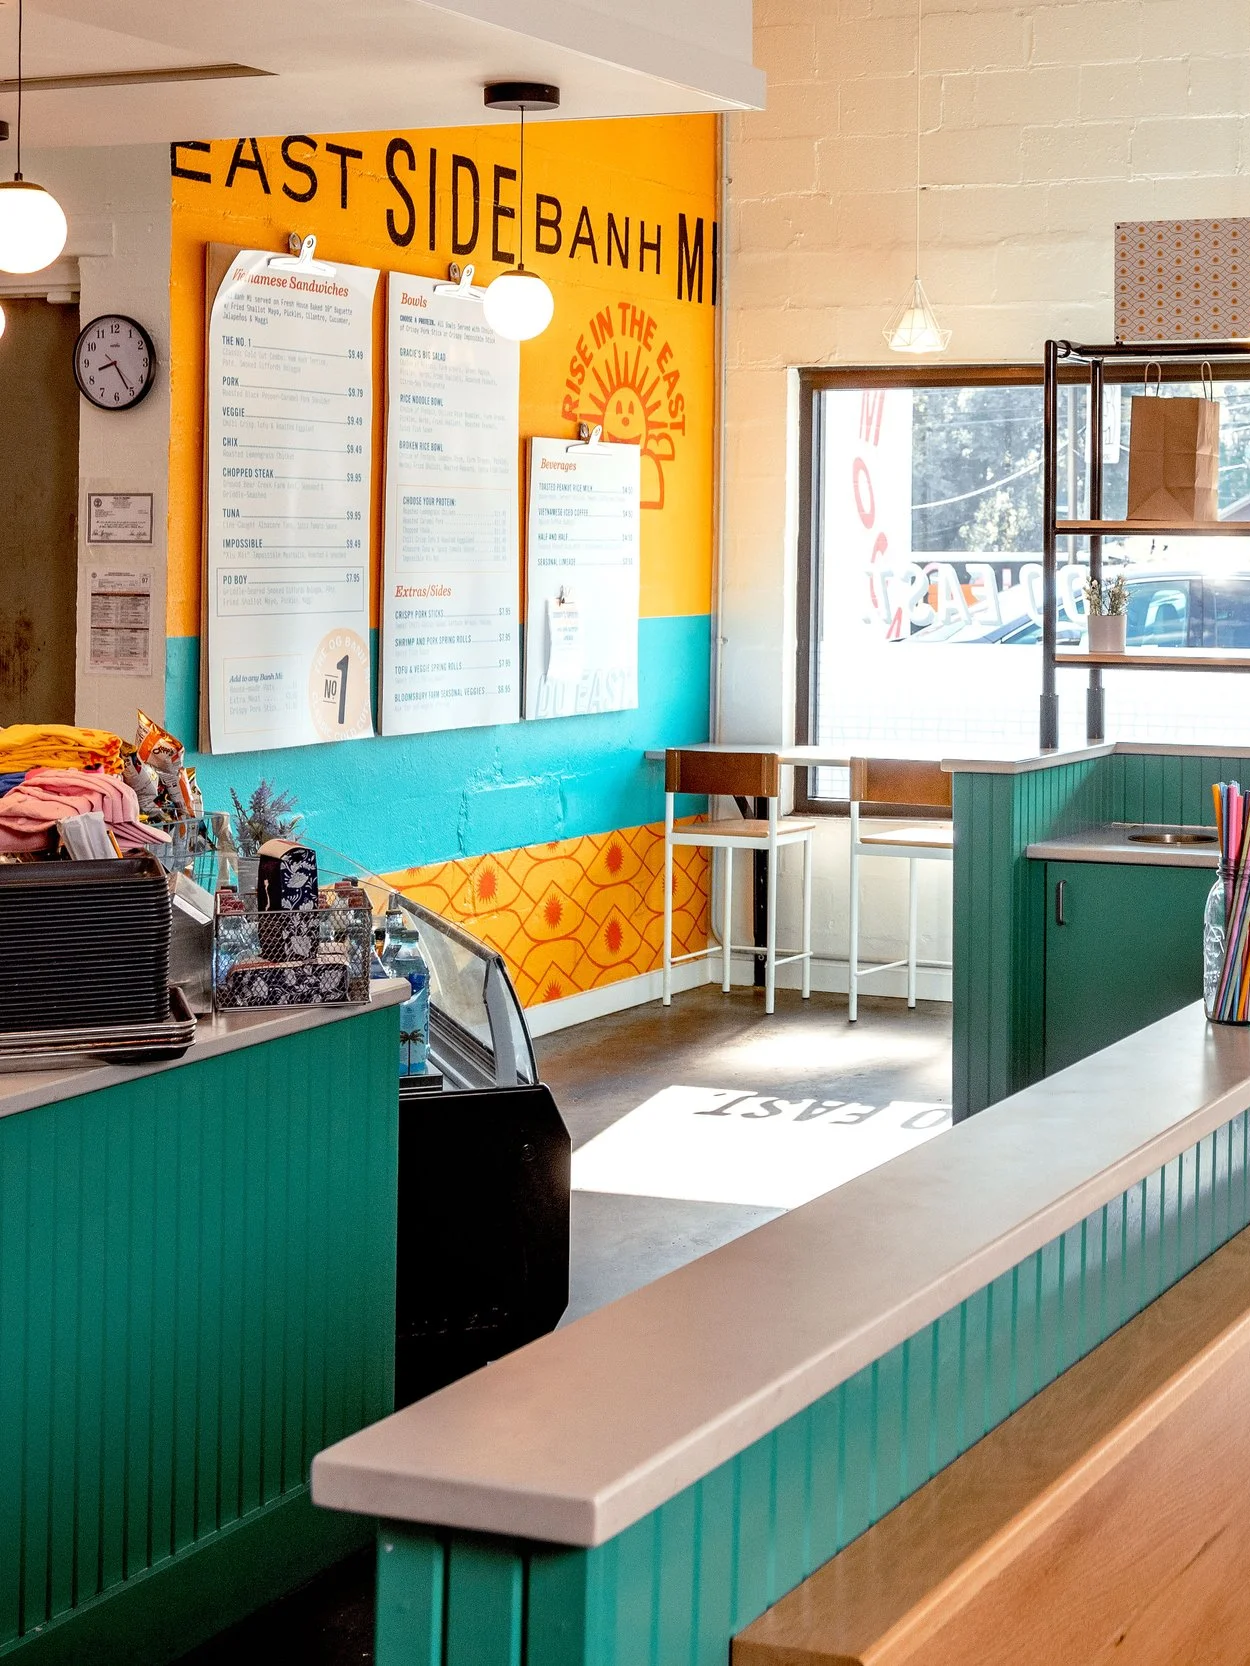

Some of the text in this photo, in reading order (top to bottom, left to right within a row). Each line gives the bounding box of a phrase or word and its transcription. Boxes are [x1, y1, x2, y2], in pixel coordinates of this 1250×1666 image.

[170, 135, 363, 209] EAST
[385, 137, 517, 265] SIDE
[535, 193, 661, 275] BANH
[232, 268, 349, 297] Vienamese Sandwiches
[401, 293, 427, 308] Bowls
[97, 329, 105, 338] 11
[110, 324, 120, 334] 12
[128, 329, 132, 338] 1
[87, 342, 96, 352] 10
[137, 340, 143, 350] 2
[222, 335, 234, 346] THE
[235, 337, 247, 347] NO.
[348, 350, 364, 360] $9.49
[83, 359, 90, 368] 9
[143, 358, 148, 367] 3
[561, 333, 594, 422] RISE
[589, 306, 614, 349] IN
[618, 302, 657, 352] THE
[656, 341, 685, 436] EAST
[89, 375, 95, 385] 8
[100, 387, 105, 397] 7
[129, 387, 135, 397] 5
[222, 376, 364, 397] PORK $9.79
[114, 392, 119, 402] 6
[400, 394, 411, 404] RICE
[222, 407, 363, 426] VEGGIE $9.49
[222, 437, 362, 454] CHIX $9.49
[399, 440, 418, 450] BROKEN
[420, 442, 430, 451] RICE
[541, 458, 577, 472] Beverages
[222, 467, 362, 483] CHOPPED STEAK $9.95
[403, 496, 421, 505] CHOOSE
[423, 496, 435, 505] YOUR
[222, 508, 240, 518] TUNA
[222, 538, 361, 549] IMPOSSIBLE $9.49
[222, 573, 360, 585] PO BOY $7.95
[395, 584, 452, 598] Extras/Sides
[395, 610, 413, 619] CRISPY
[415, 610, 427, 618] PORK
[428, 609, 443, 618] STICKS
[395, 637, 415, 647] SHRIMP
[416, 637, 425, 646] AND
[427, 636, 438, 645] PORK
[439, 635, 455, 644] SPRING
[457, 634, 472, 643] ROLLS
[395, 665, 409, 674] TOFU
[414, 663, 430, 673] VEGGIE
[448, 661, 463, 670] ROLLS
[229, 674, 242, 683] Add
[242, 674, 248, 682] to
[260, 673, 274, 681] Banh
[336, 654, 349, 724] 1
[395, 691, 427, 702] BLOOMSBURY
[464, 686, 486, 696] VEGGIES
